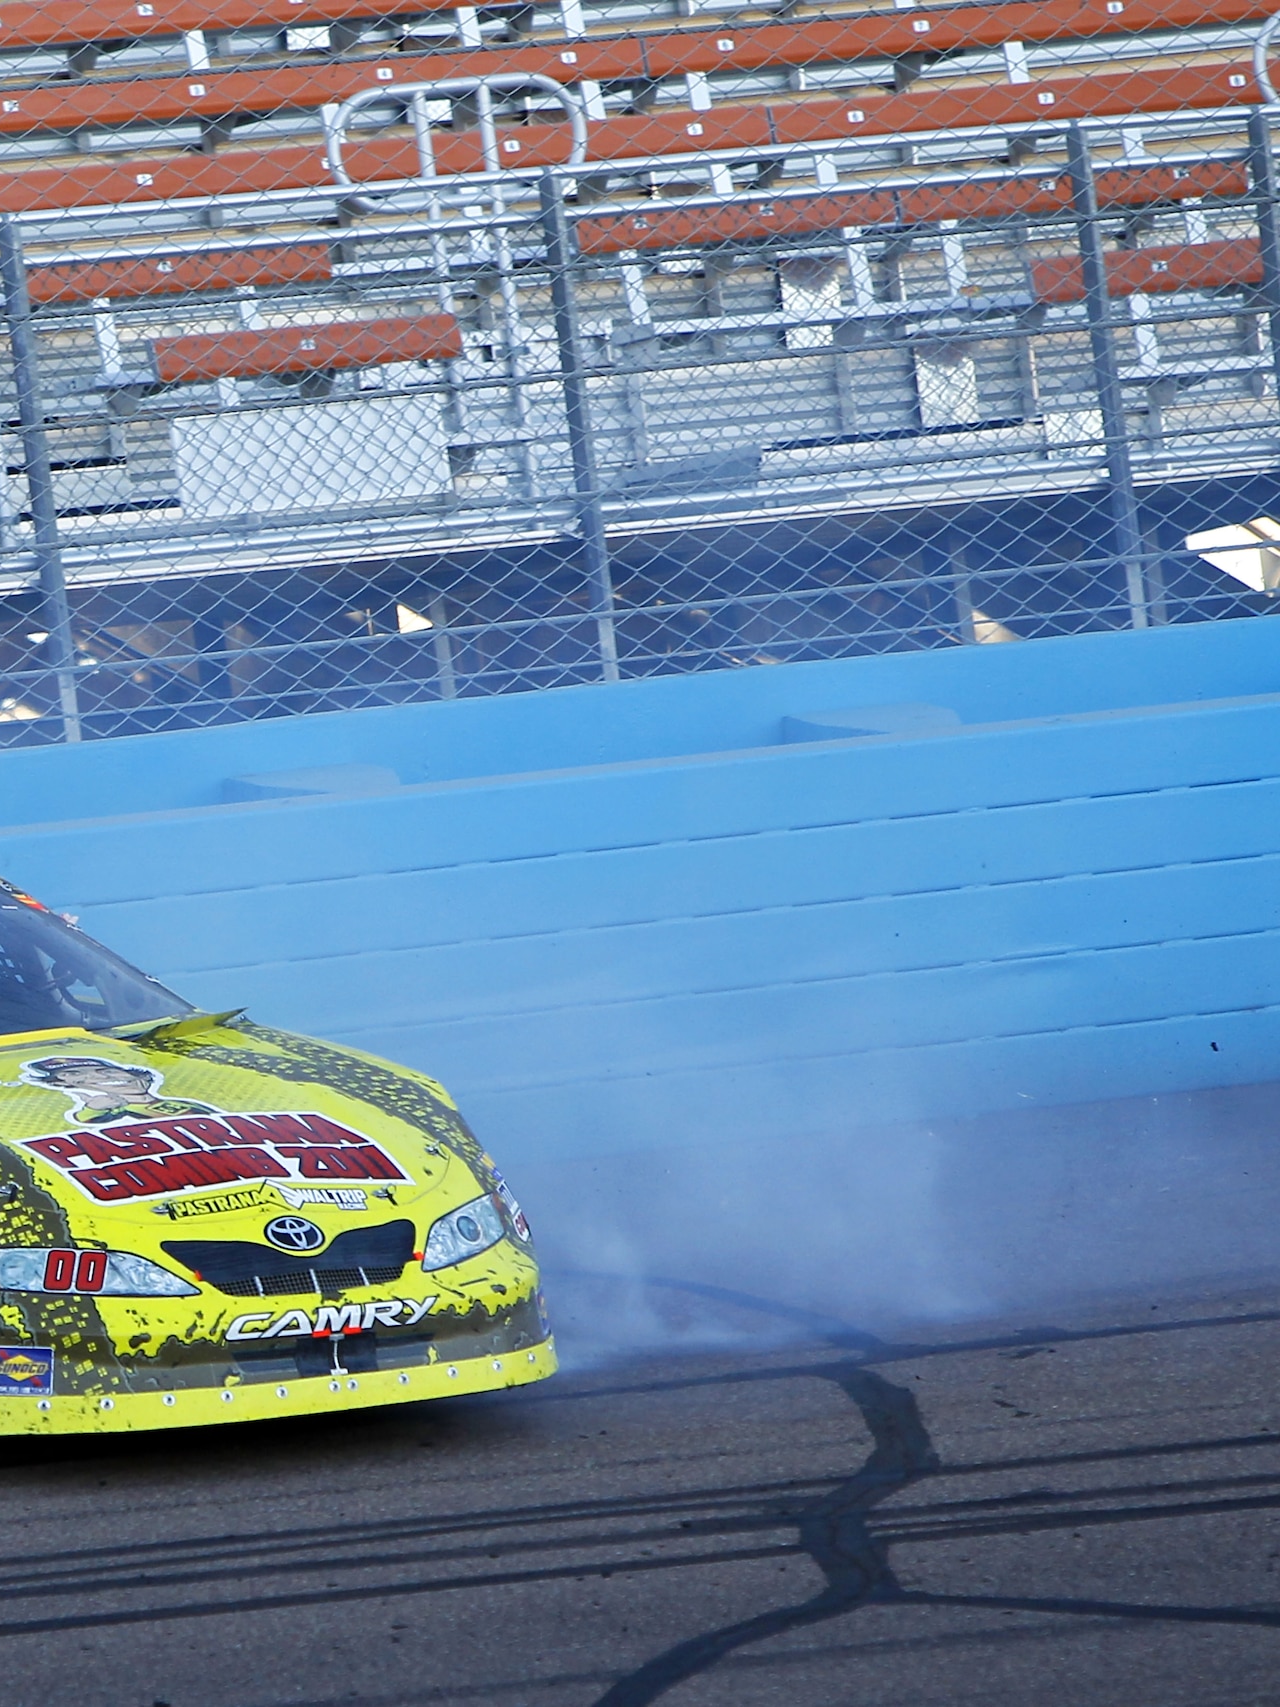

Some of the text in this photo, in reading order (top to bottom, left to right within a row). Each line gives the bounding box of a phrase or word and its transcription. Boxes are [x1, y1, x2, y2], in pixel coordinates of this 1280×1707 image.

[21, 1113, 370, 1168] PASTRANA
[69, 1144, 408, 1201] COMING 2011
[174, 1190, 276, 1218] PASTRANA
[286, 1187, 369, 1206] WALTRIP
[337, 1202, 369, 1211] RACING
[44, 1249, 108, 1293] 00
[223, 1297, 439, 1342] CAMRY
